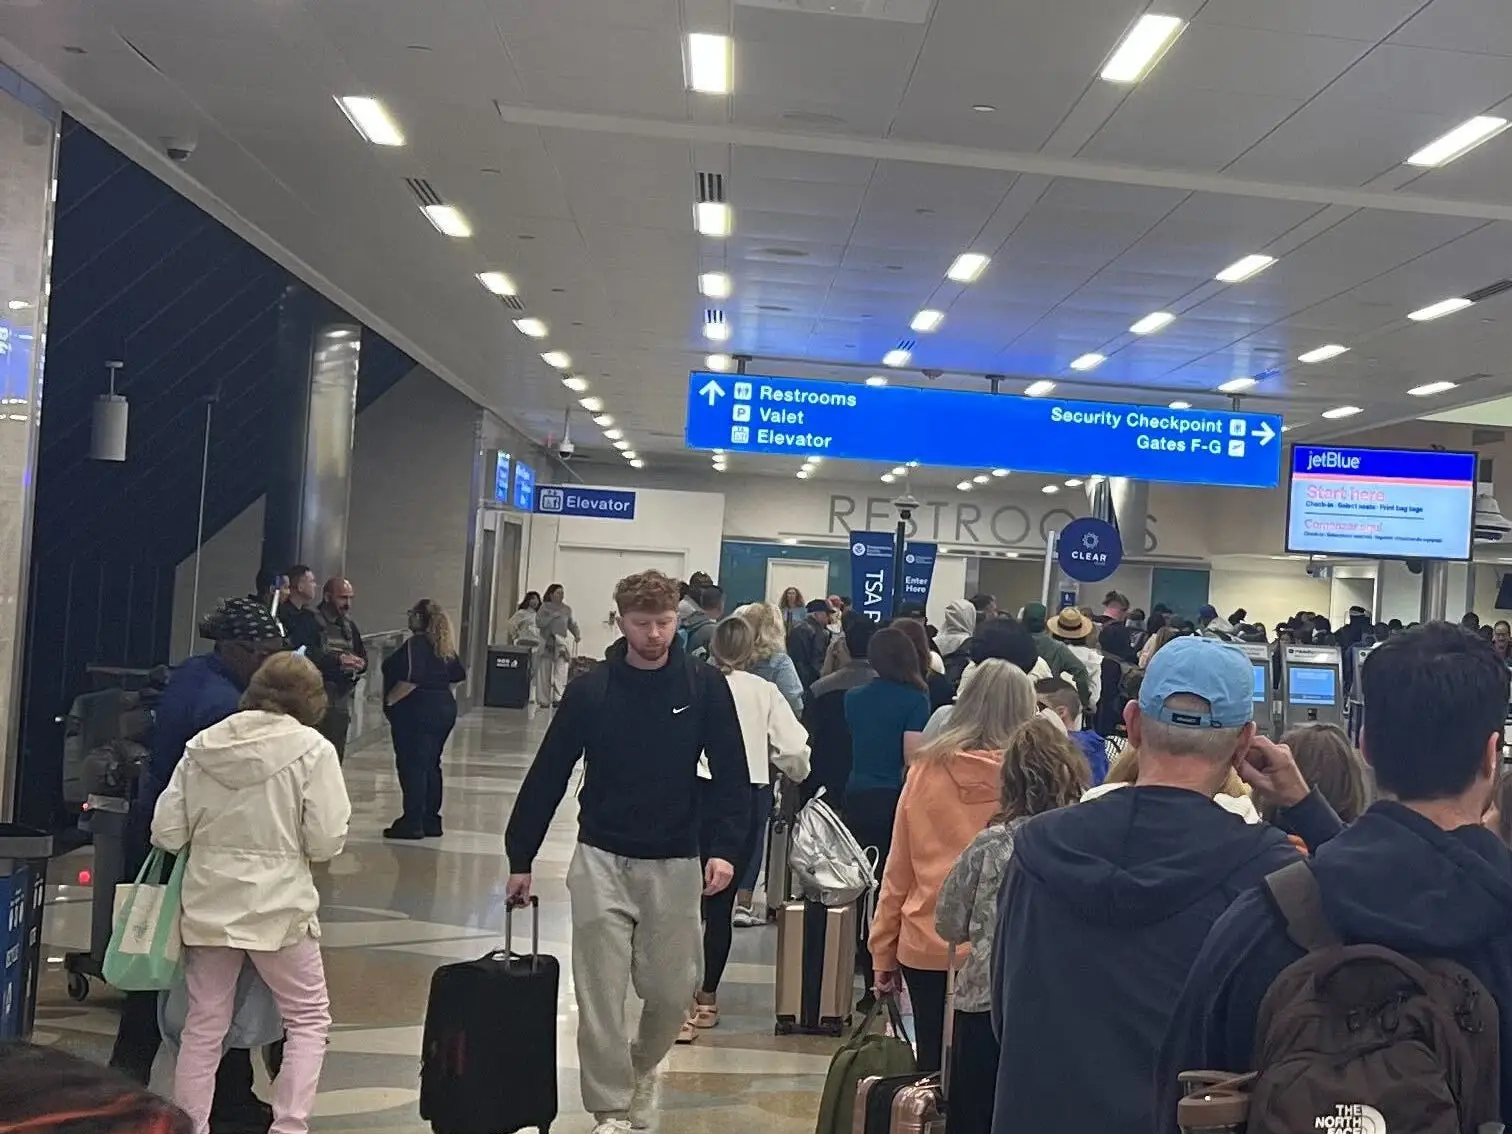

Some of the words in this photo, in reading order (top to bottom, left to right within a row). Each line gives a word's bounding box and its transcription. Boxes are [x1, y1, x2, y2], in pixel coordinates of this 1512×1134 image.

[759, 385, 857, 407] Restrooms
[759, 407, 805, 425] Valet
[1050, 406, 1121, 429] Security
[1126, 412, 1223, 433] Checkpoint
[757, 429, 833, 448] Elevator
[1137, 435, 1186, 452] Gates
[1191, 438, 1222, 454] F-G
[1306, 451, 1361, 470] jetBlue
[1306, 484, 1346, 500] Start
[1350, 486, 1385, 502] here
[566, 495, 630, 512] Elevator
[1071, 551, 1107, 561] CLEAR
[863, 569, 884, 606] TSA
[905, 575, 928, 585] Enter
[905, 585, 926, 593] Here
[1336, 1104, 1361, 1116] THE
[1315, 1116, 1361, 1128] NORTH
